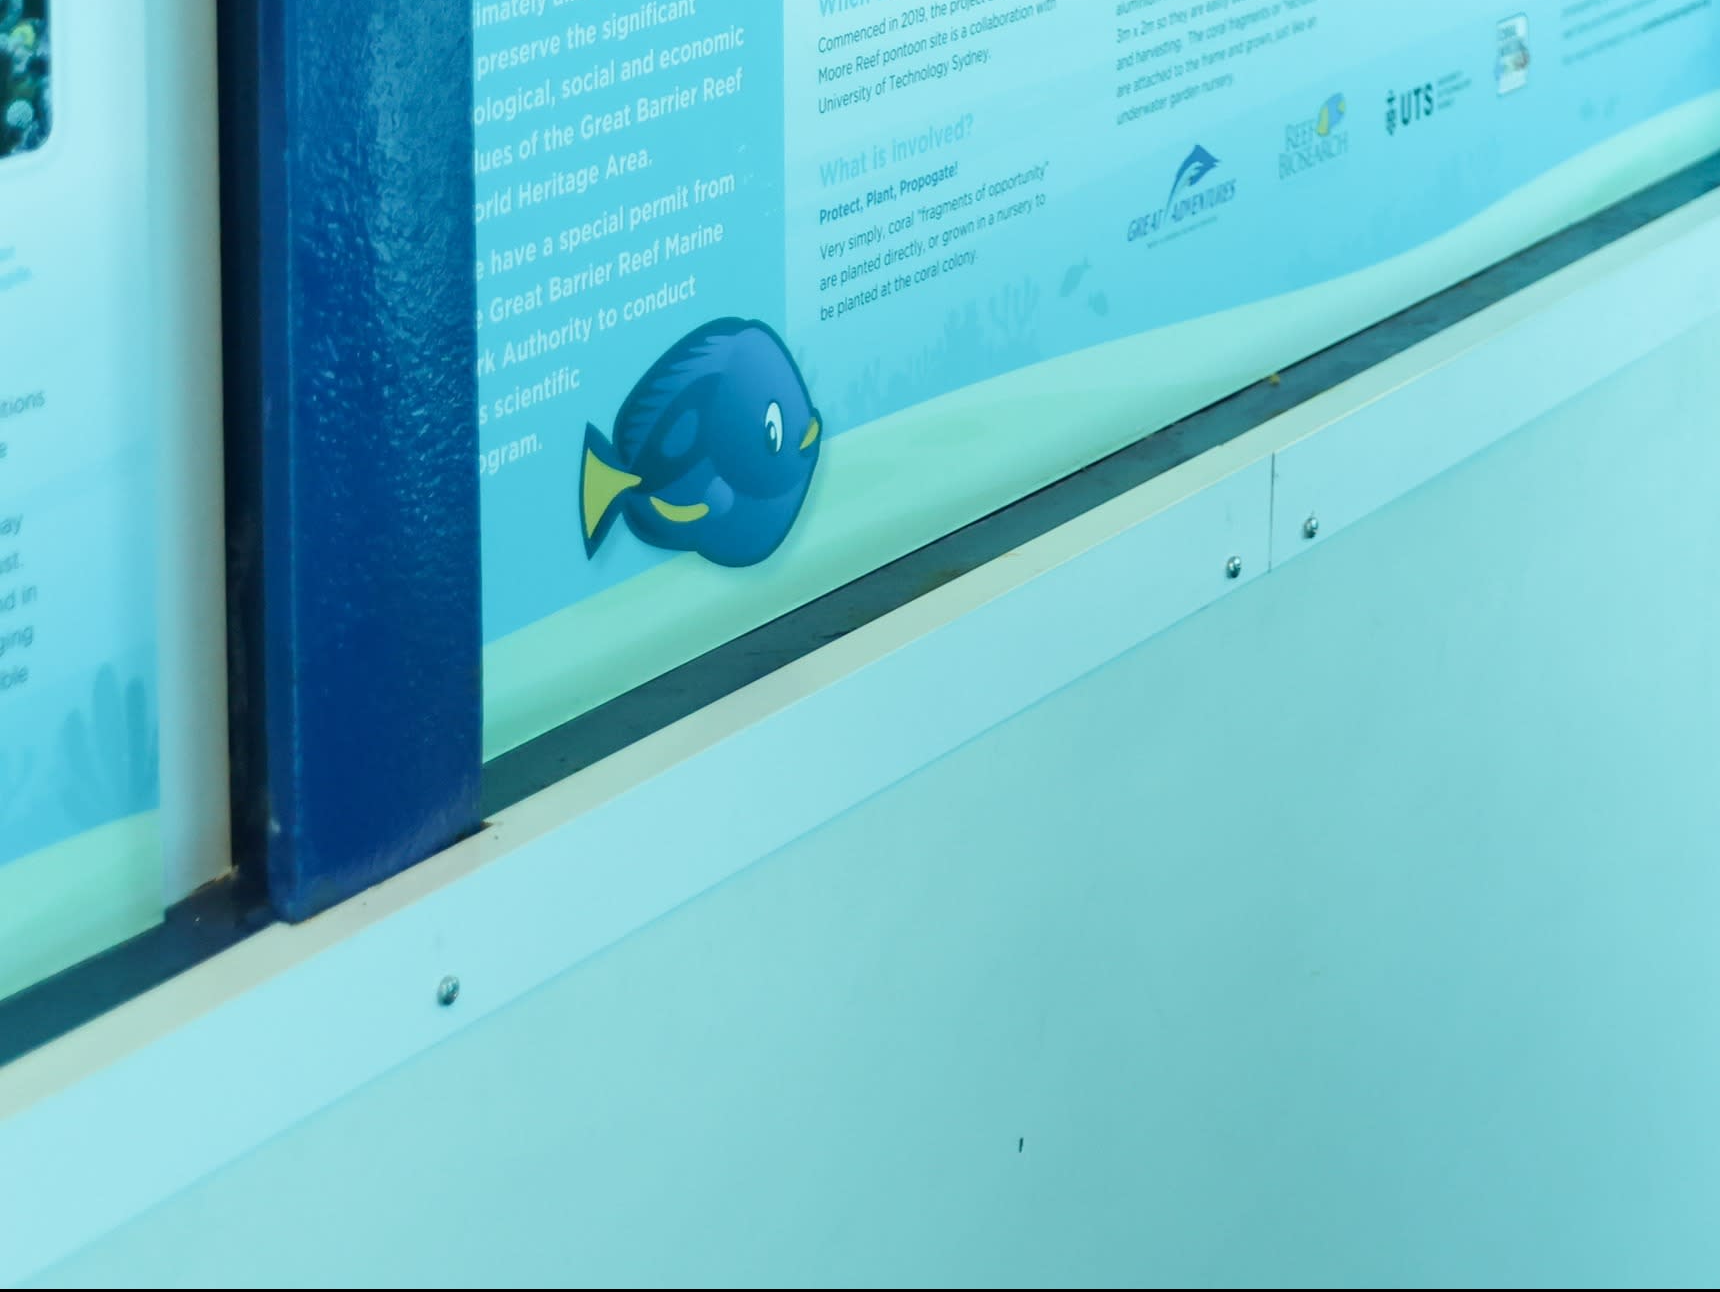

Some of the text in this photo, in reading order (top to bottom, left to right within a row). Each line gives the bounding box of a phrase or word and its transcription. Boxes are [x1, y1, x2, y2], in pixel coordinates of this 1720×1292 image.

[474, 28, 744, 122] ological, social and economic
[476, 36, 560, 80] preserve
[566, 24, 596, 49] the
[475, 69, 742, 173] lues of the Great Barrier Reef
[1400, 83, 1433, 126] UTS
[476, 153, 651, 220] orld Heritage Area.
